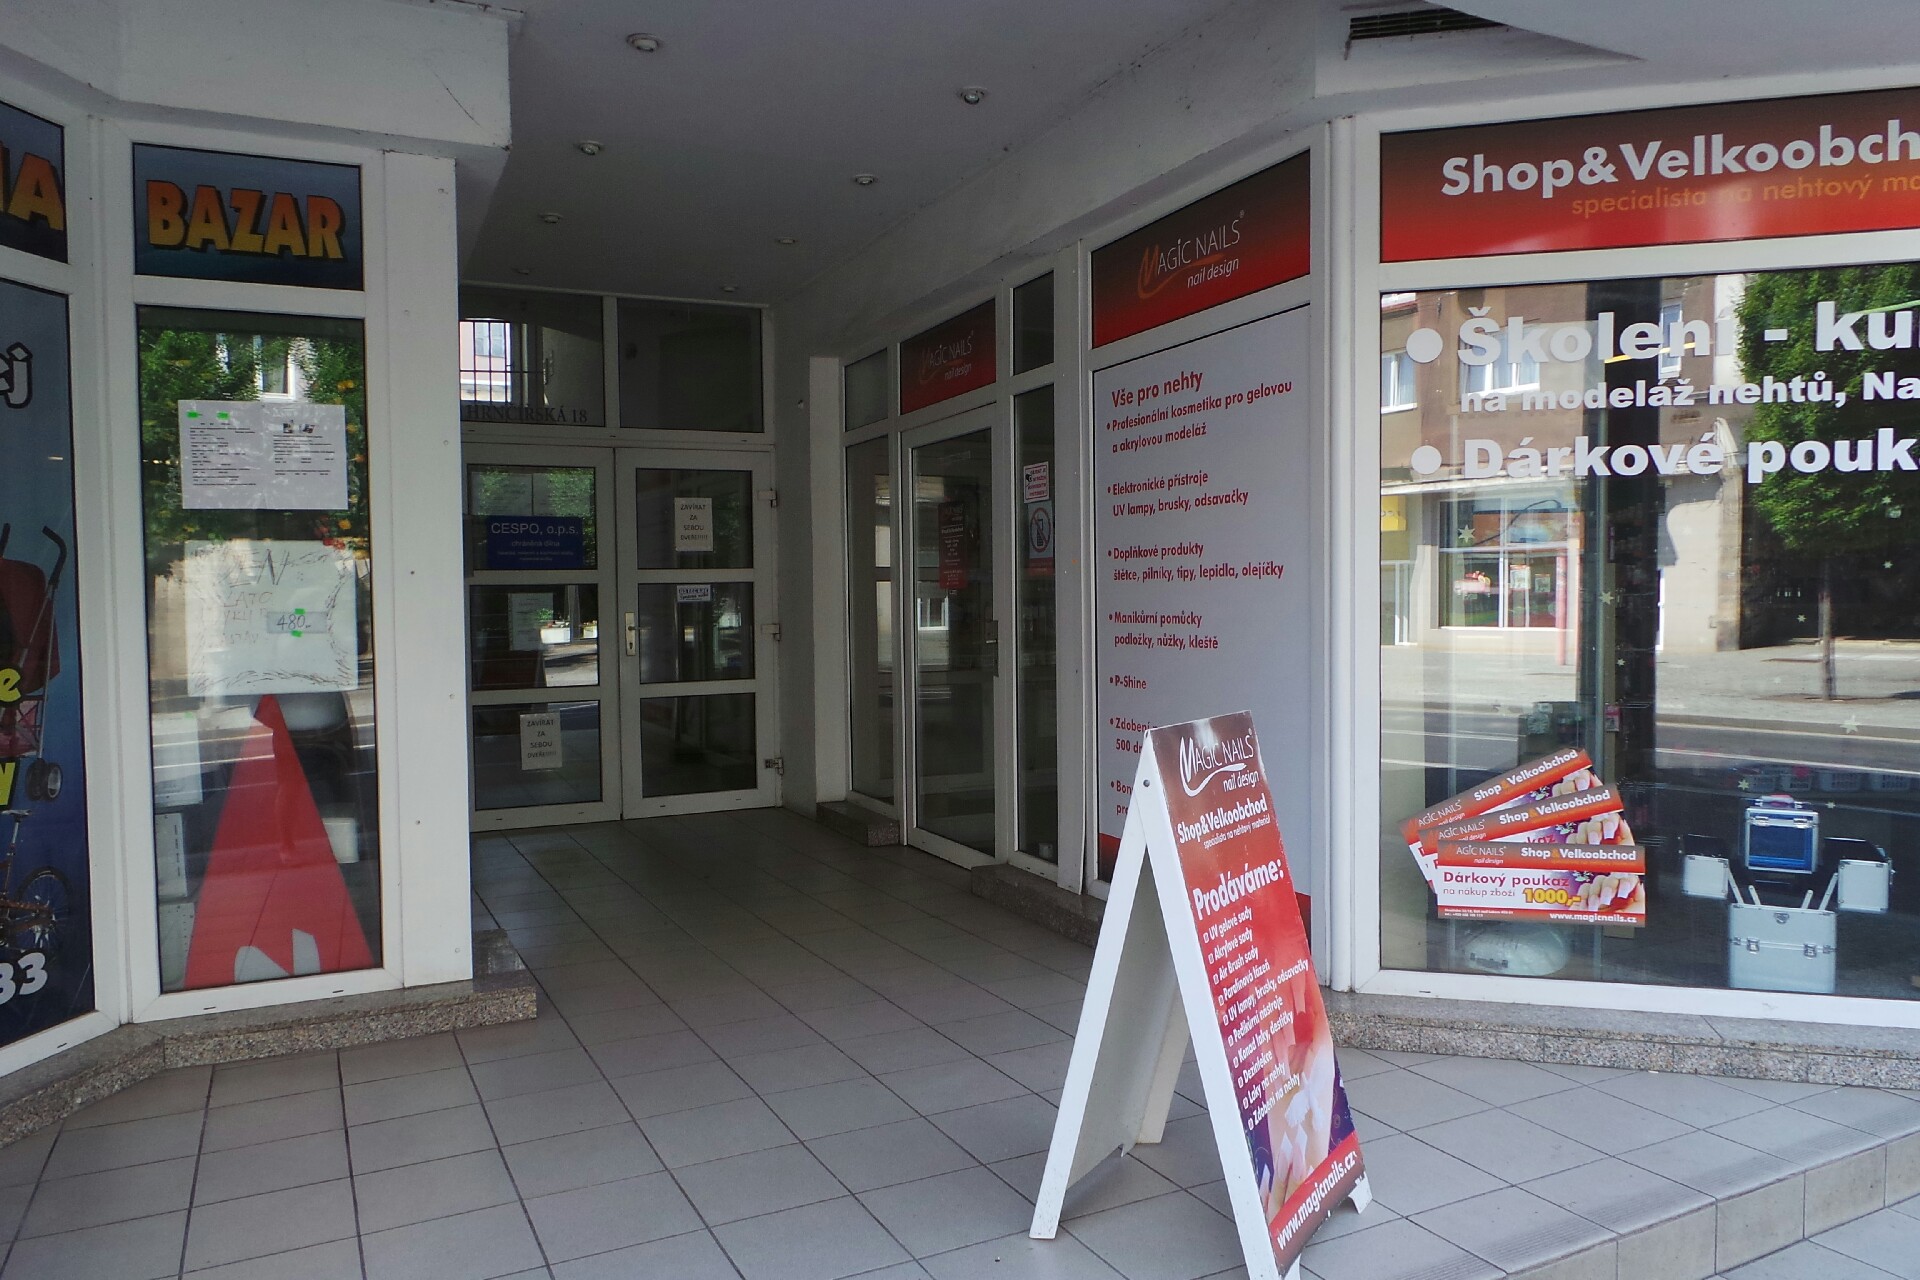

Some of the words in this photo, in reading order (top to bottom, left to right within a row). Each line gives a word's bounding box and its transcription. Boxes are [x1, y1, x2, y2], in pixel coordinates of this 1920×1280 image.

[1441, 119, 1920, 198] Shop&Velkoobch
[0, 140, 65, 231] A
[1572, 186, 1706, 218] specialista
[1718, 186, 1753, 202] na
[1763, 174, 1873, 202] nehtový
[146, 179, 344, 260] BAZAR
[1187, 270, 1205, 289] nail
[1207, 257, 1239, 280] design
[1112, 387, 1133, 408] Vše
[1137, 384, 1160, 406] pro
[1163, 371, 1203, 395] nehty
[1461, 391, 1507, 412] na
[1522, 378, 1695, 411] modeláž
[1709, 371, 1847, 408] nehtů,
[572, 409, 588, 423] 18
[1112, 406, 1169, 431] Profesionální
[1171, 395, 1222, 418] kosmetika
[1225, 392, 1244, 410] pro
[1246, 381, 1292, 404] gelovou
[1112, 442, 1118, 453] a
[1120, 433, 1163, 452] akrylovou
[1165, 422, 1207, 443] modeláž
[1464, 431, 1726, 481] Dárkové
[1112, 476, 1165, 496] Elektronické
[1168, 470, 1209, 490] přístroje
[1113, 504, 1126, 517] UV
[1127, 501, 1156, 517] lampy,
[1158, 496, 1192, 512] brusky,
[1195, 489, 1249, 508] odsavačky
[491, 522, 543, 536] CESPO,
[546, 525, 579, 537] o.p.s.
[1113, 545, 1159, 561] Doplňkové
[1161, 541, 1204, 559] produkty
[1142, 566, 1174, 583] pilníky,
[1177, 565, 1197, 582] tipy,
[1200, 562, 1239, 581] lepidla,
[1242, 560, 1284, 580] olejíčky
[1114, 609, 1158, 624] Manikůrní
[1160, 609, 1203, 628] pomůcky
[1114, 632, 1155, 648] podložky,
[1157, 632, 1186, 650] nůžky,
[1189, 634, 1219, 649] kleště
[1115, 674, 1147, 690] P-Shine
[1115, 738, 1131, 752] 500
[1116, 780, 1133, 795] Bon
[1223, 772, 1238, 792] nail
[1238, 769, 1259, 788] design
[1177, 793, 1268, 844] Shop&Velkoobchod
[1193, 859, 1284, 920] Prodáváme:
[1443, 871, 1506, 888] Dárkový
[1512, 874, 1570, 888] poukaz
[1458, 887, 1488, 898] nákup
[1490, 887, 1515, 897] zboží
[1522, 887, 1582, 908] 1000,-
[1208, 923, 1218, 940] UV
[1218, 912, 1238, 938] gelové
[1238, 905, 1253, 923] sady
[1549, 912, 1638, 924] www.magicnails.cz
[1214, 934, 1239, 961] Akrylové
[1239, 927, 1253, 944] sady
[1219, 965, 1228, 980] Air
[1227, 953, 1245, 974] Brush
[1244, 945, 1258, 963] sady
[1227, 1003, 1238, 1021] UV
[1236, 993, 1257, 1014] lampy,
[1255, 978, 1277, 1000] brusky,
[1277, 958, 1309, 984] odsavačky
[1259, 995, 1284, 1021] nástroje
[1255, 1029, 1271, 1047] laky,
[1270, 1010, 1294, 1035] destičky
[1242, 1050, 1273, 1083] Dezinfekce
[1247, 1083, 1262, 1104] Laky
[1261, 1076, 1269, 1090] na
[1269, 1062, 1286, 1083] nehty
[1252, 1091, 1275, 1126] Zdobení
[1275, 1087, 1284, 1101] na
[1283, 1073, 1300, 1094] nehty
[1276, 1151, 1357, 1251] www.magicnails.cz
